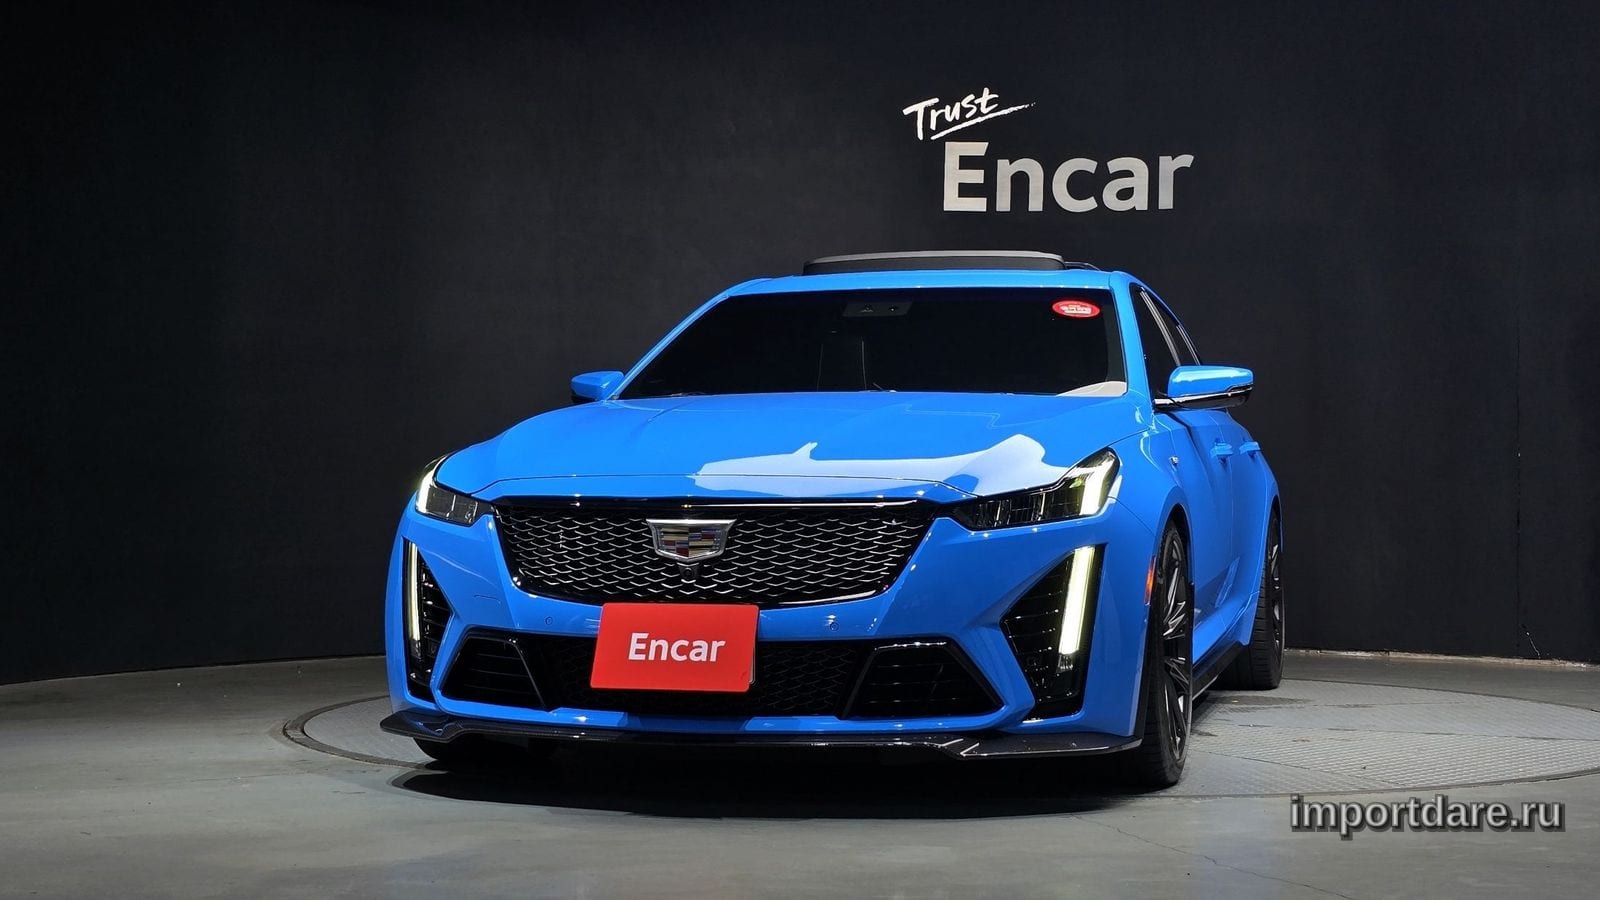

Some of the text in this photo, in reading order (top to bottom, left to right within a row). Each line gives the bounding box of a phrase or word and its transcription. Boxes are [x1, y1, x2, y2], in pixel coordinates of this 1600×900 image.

[902, 87, 999, 141] Trust
[943, 141, 1195, 213] Encar
[628, 632, 726, 662] Encar
